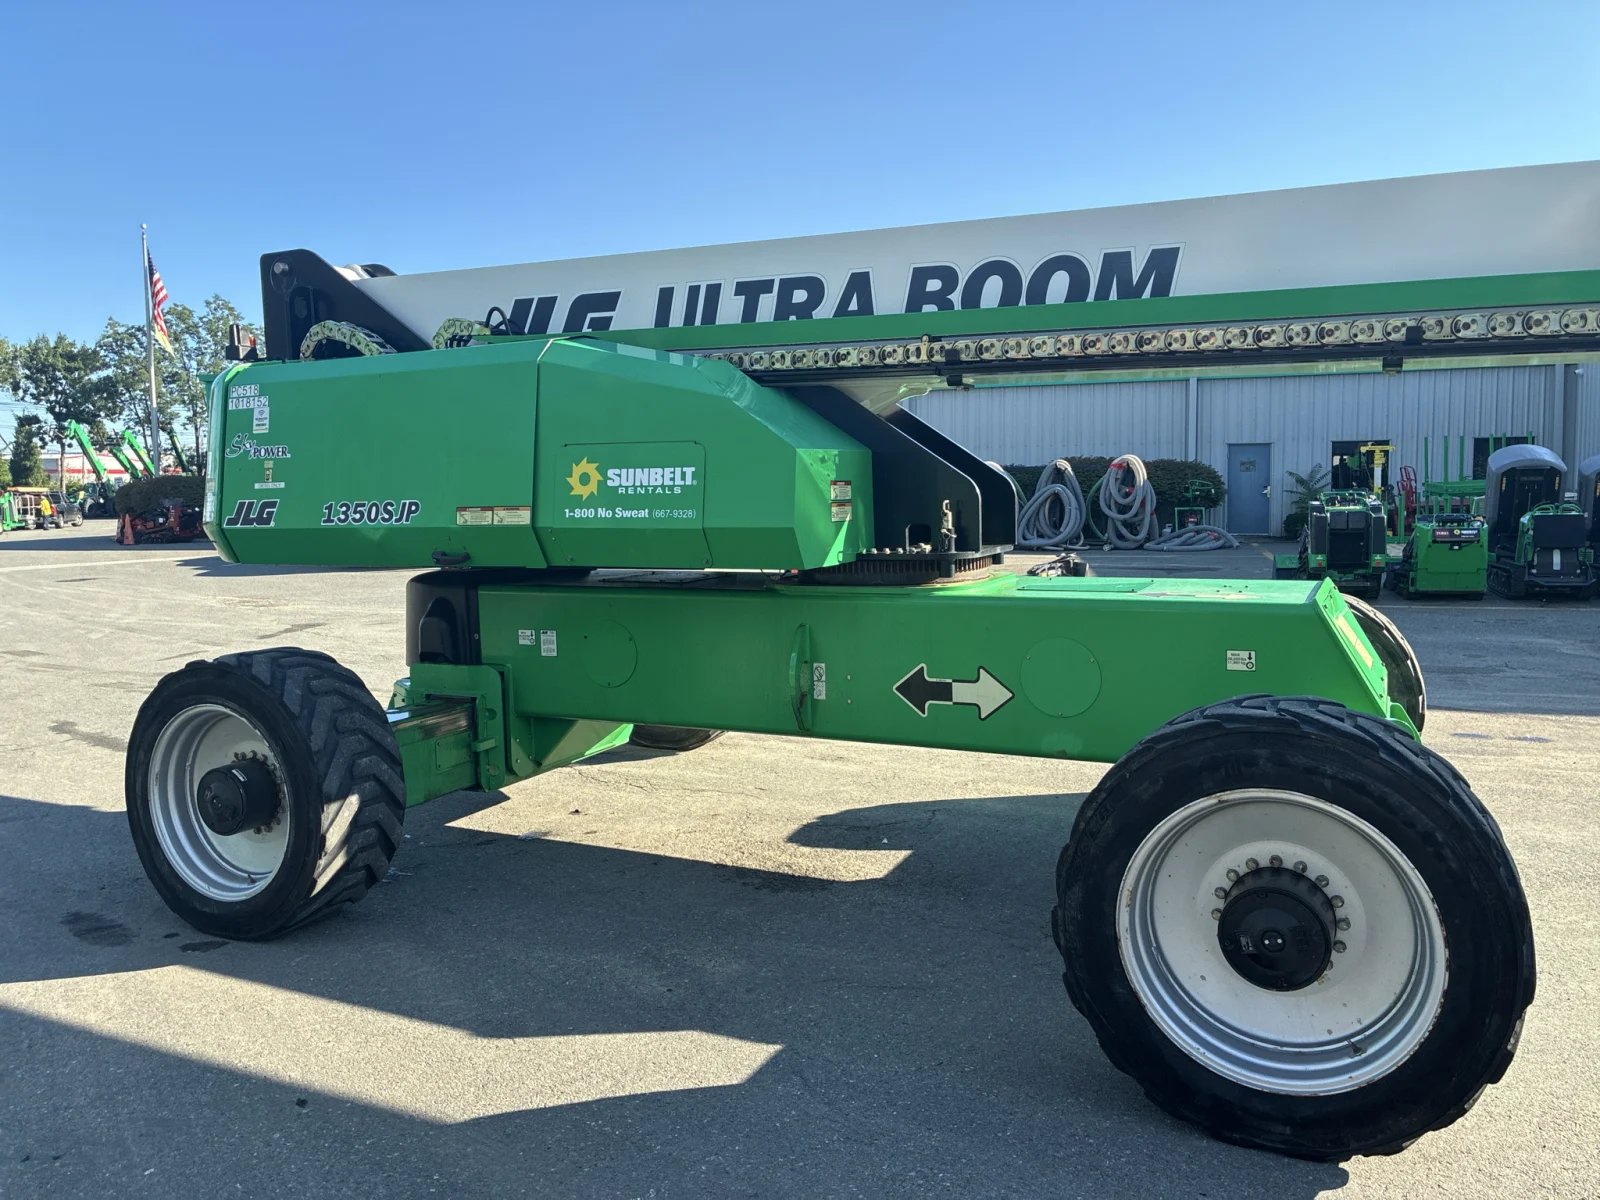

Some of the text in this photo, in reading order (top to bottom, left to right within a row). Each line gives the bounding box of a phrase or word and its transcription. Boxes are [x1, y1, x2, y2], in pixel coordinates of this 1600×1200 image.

[903, 245, 1182, 315] BOOM
[231, 385, 259, 397] PC518
[229, 396, 268, 410] 1018152
[253, 446, 288, 459] POWER
[607, 467, 696, 486] SUNBELT
[618, 486, 681, 494] RENTALS
[223, 500, 279, 527] JLG
[321, 501, 420, 525] 1350SJP
[564, 507, 696, 519] 1-800 No Sweat (667-9328)
